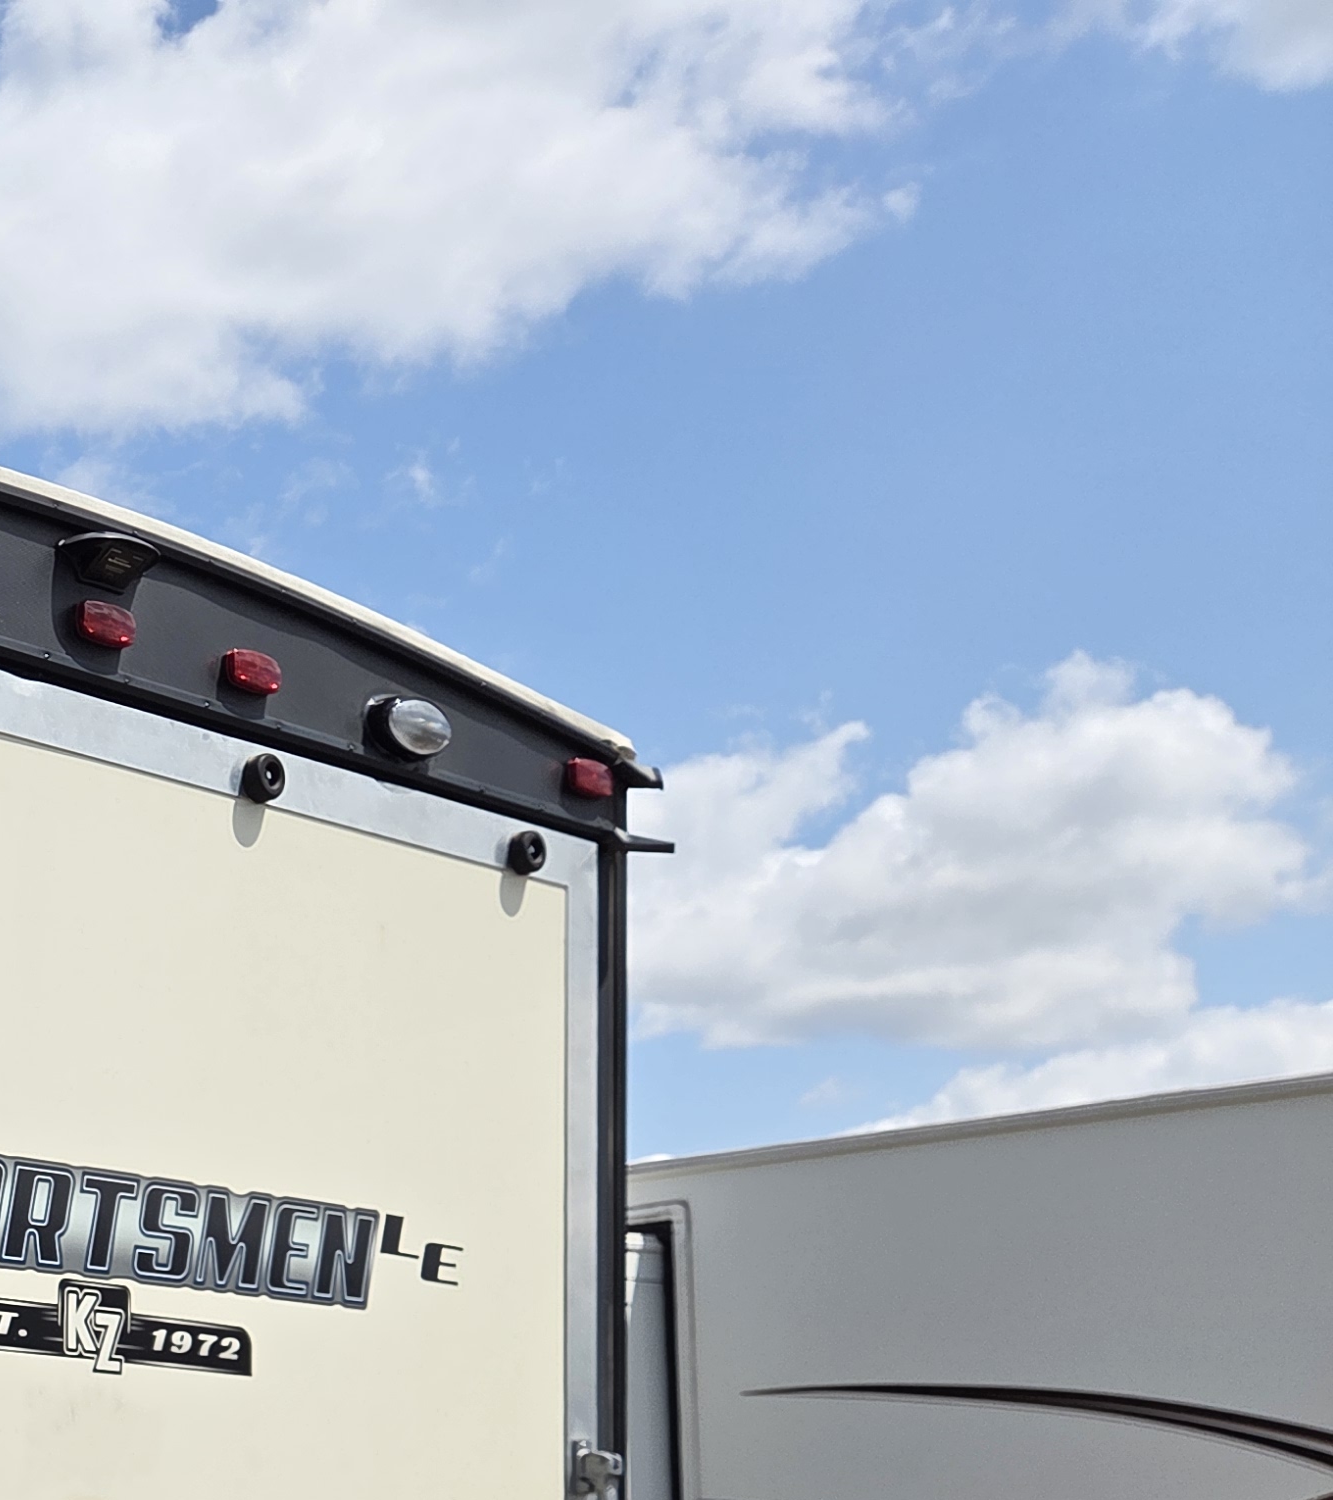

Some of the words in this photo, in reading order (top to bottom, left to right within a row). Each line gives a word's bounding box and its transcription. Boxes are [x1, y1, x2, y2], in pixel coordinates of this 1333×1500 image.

[380, 1213, 464, 1286] LE
[63, 1286, 124, 1374] KZ
[151, 1328, 241, 1361] 1972
